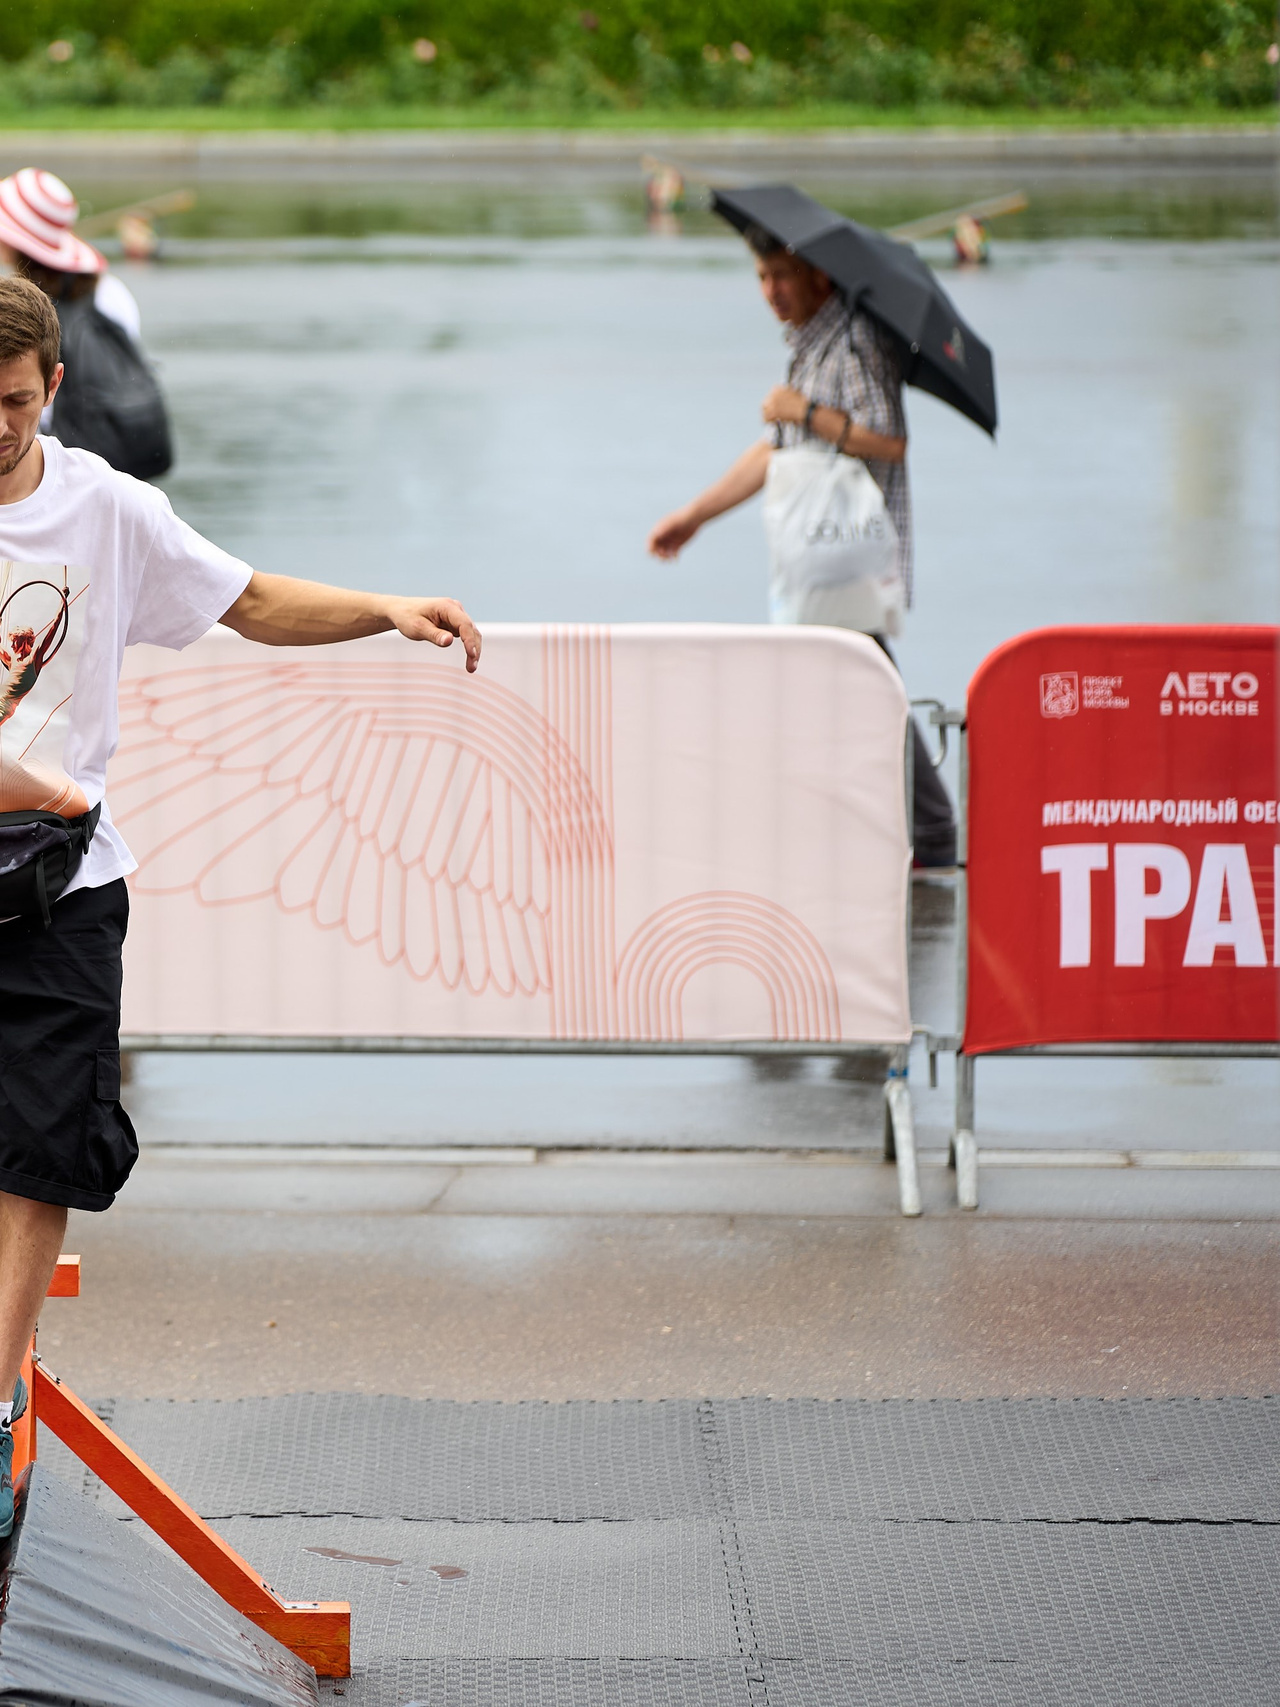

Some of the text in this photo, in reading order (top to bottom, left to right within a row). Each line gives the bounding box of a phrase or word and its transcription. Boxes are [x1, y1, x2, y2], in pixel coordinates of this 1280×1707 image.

[1160, 671, 1259, 699] ЛЕТО
[1160, 700, 1259, 716] В МОСКВЕ
[1042, 797, 1280, 827] МЕЖДУНАРОДНЫЙ ФЕ
[1040, 842, 1280, 969] ТРА
